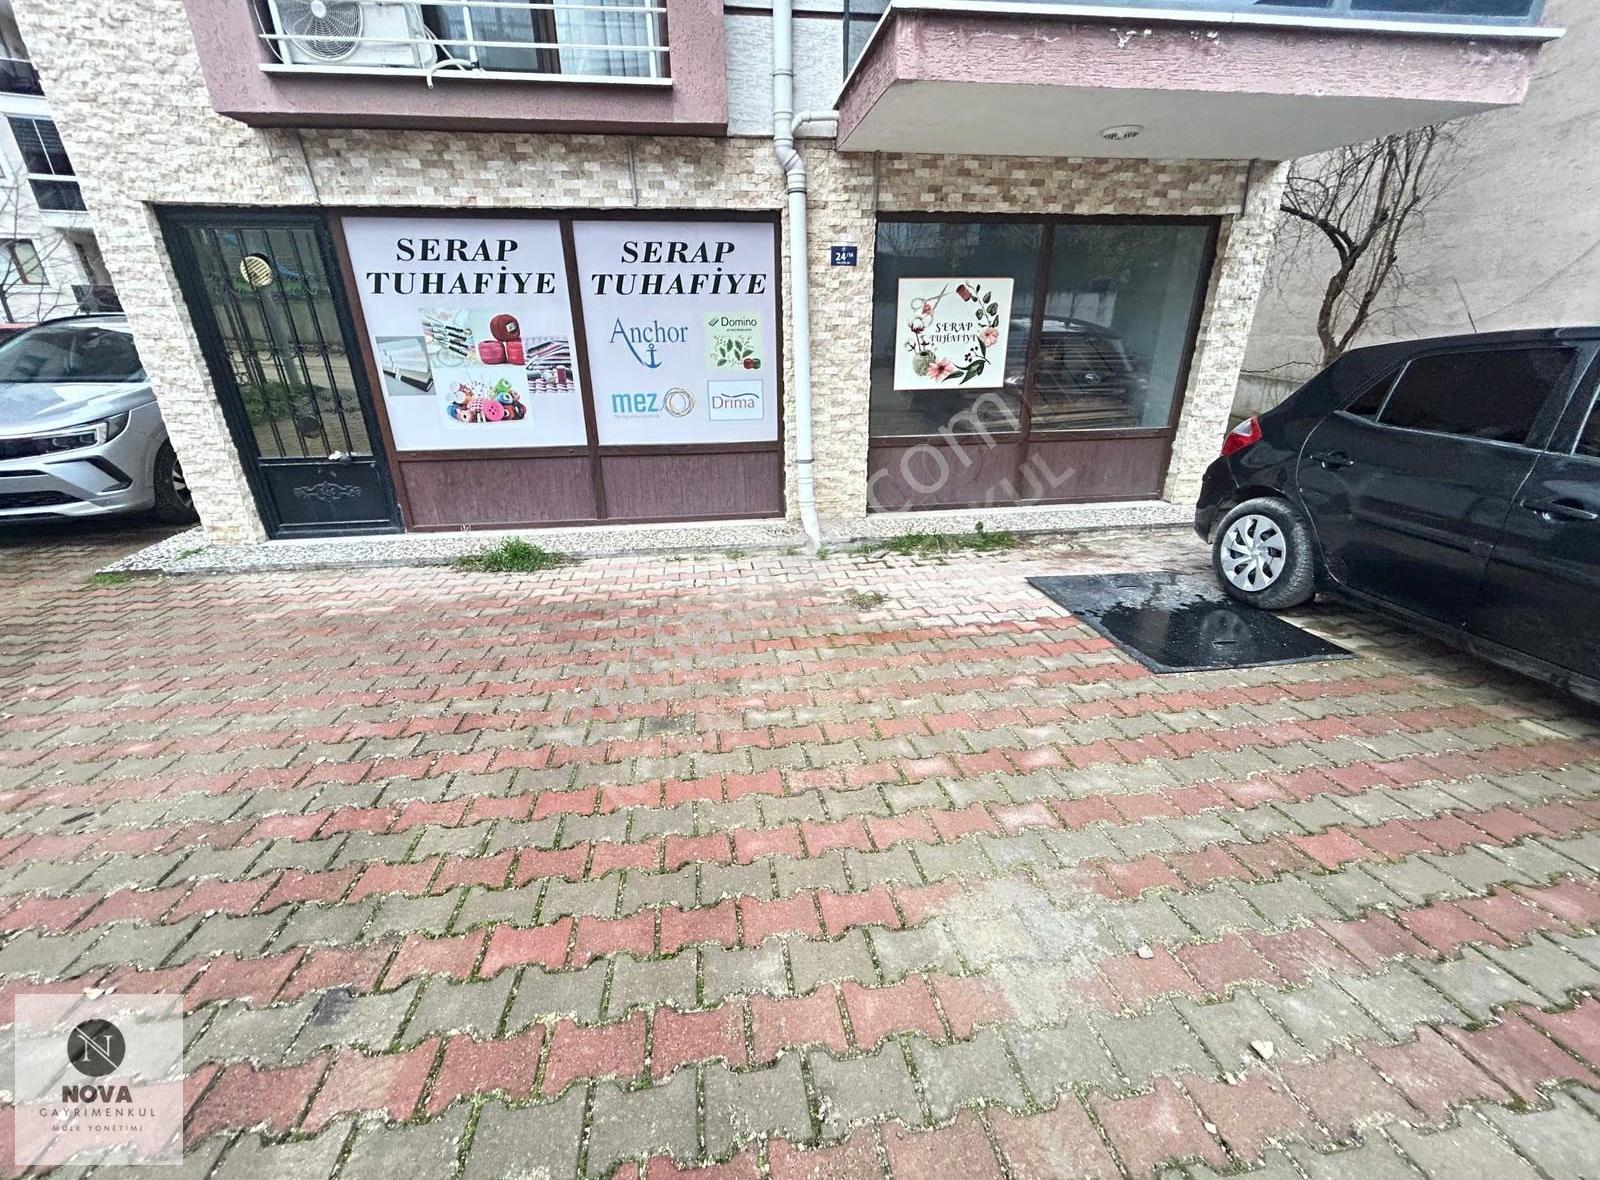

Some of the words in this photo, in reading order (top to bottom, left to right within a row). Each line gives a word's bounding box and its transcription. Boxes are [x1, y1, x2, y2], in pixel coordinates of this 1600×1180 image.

[396, 237, 518, 262] SERAP
[621, 241, 735, 264] SERAP
[366, 266, 556, 295] TUHAFİYE
[591, 267, 767, 296] TUHAFİYE
[720, 317, 757, 328] Domino
[935, 322, 973, 333] SERAP
[609, 317, 689, 362] Anchor
[611, 392, 659, 413] mez
[712, 396, 755, 409] Drima
